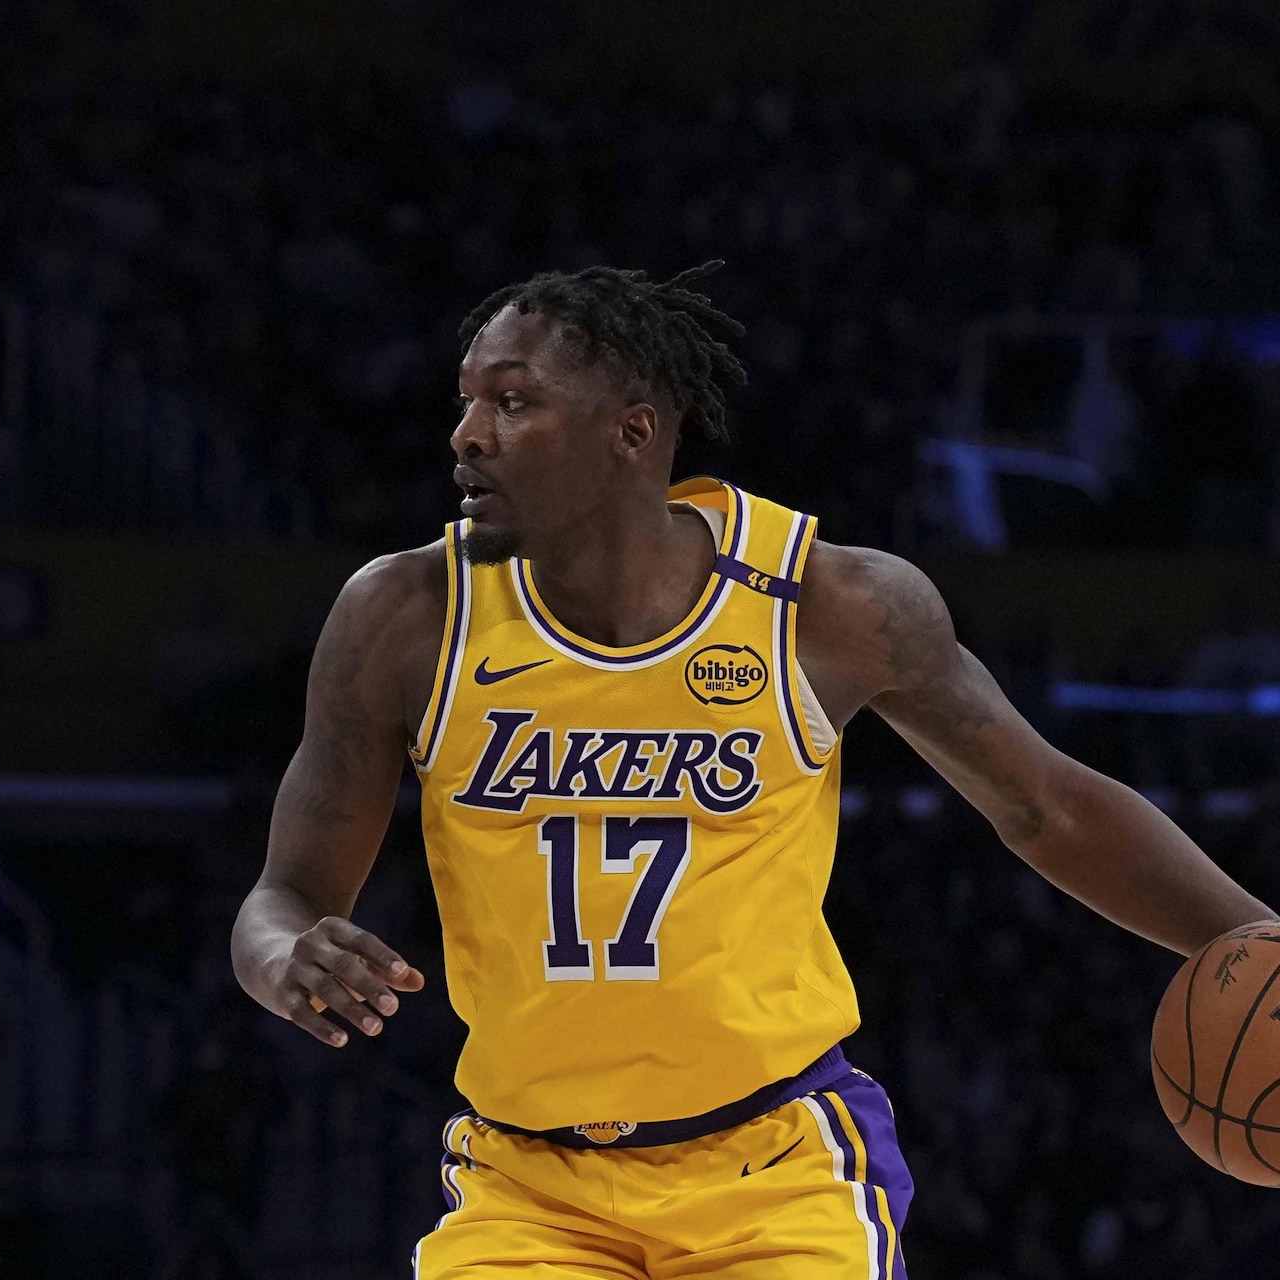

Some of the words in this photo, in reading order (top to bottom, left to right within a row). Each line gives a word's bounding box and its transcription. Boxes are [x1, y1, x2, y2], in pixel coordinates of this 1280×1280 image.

[747, 571, 771, 592] 44
[693, 660, 763, 687] bibigo
[705, 681, 735, 692] 비비고
[450, 708, 765, 816] LAKERS
[537, 812, 692, 982] 17
